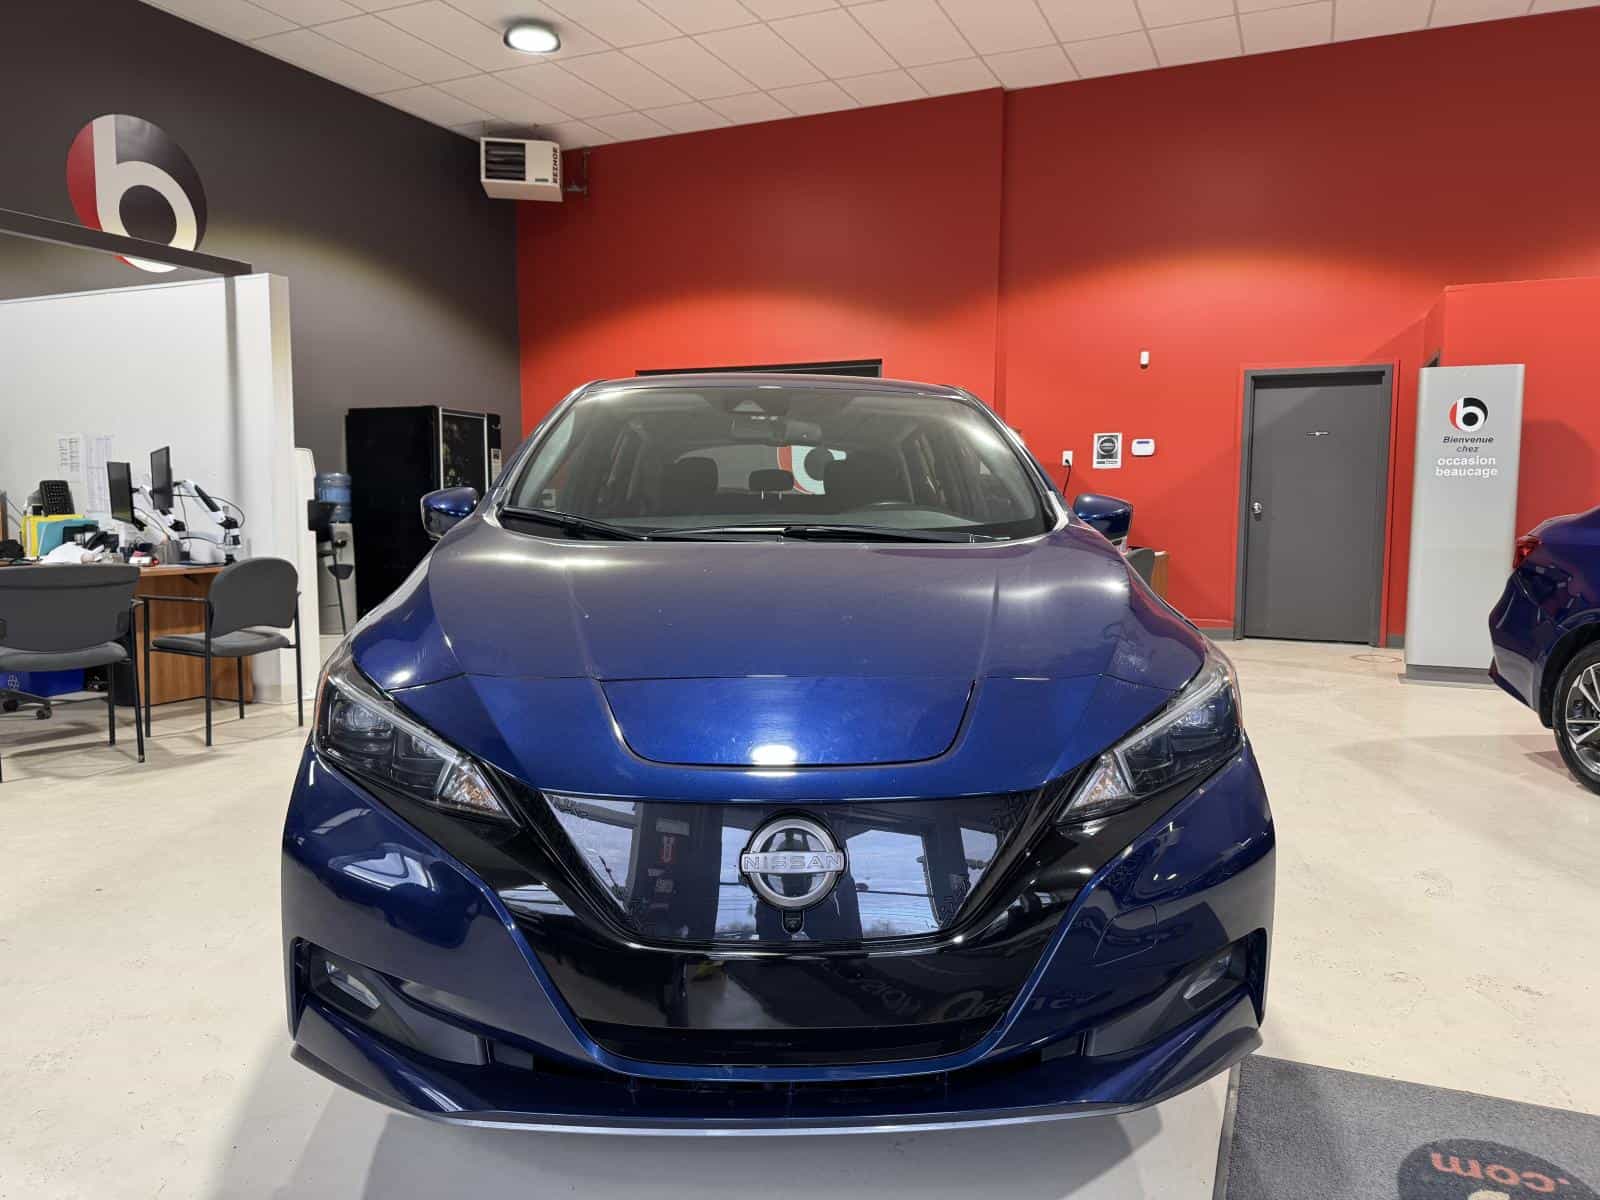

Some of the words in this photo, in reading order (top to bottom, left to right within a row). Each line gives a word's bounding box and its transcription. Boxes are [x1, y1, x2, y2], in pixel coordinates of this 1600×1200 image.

[1442, 435, 1495, 444] Bienvenue
[1456, 445, 1480, 453] chez
[1437, 455, 1497, 466] occasion
[1435, 466, 1498, 478] beaucage
[743, 854, 841, 871] NISSAN
